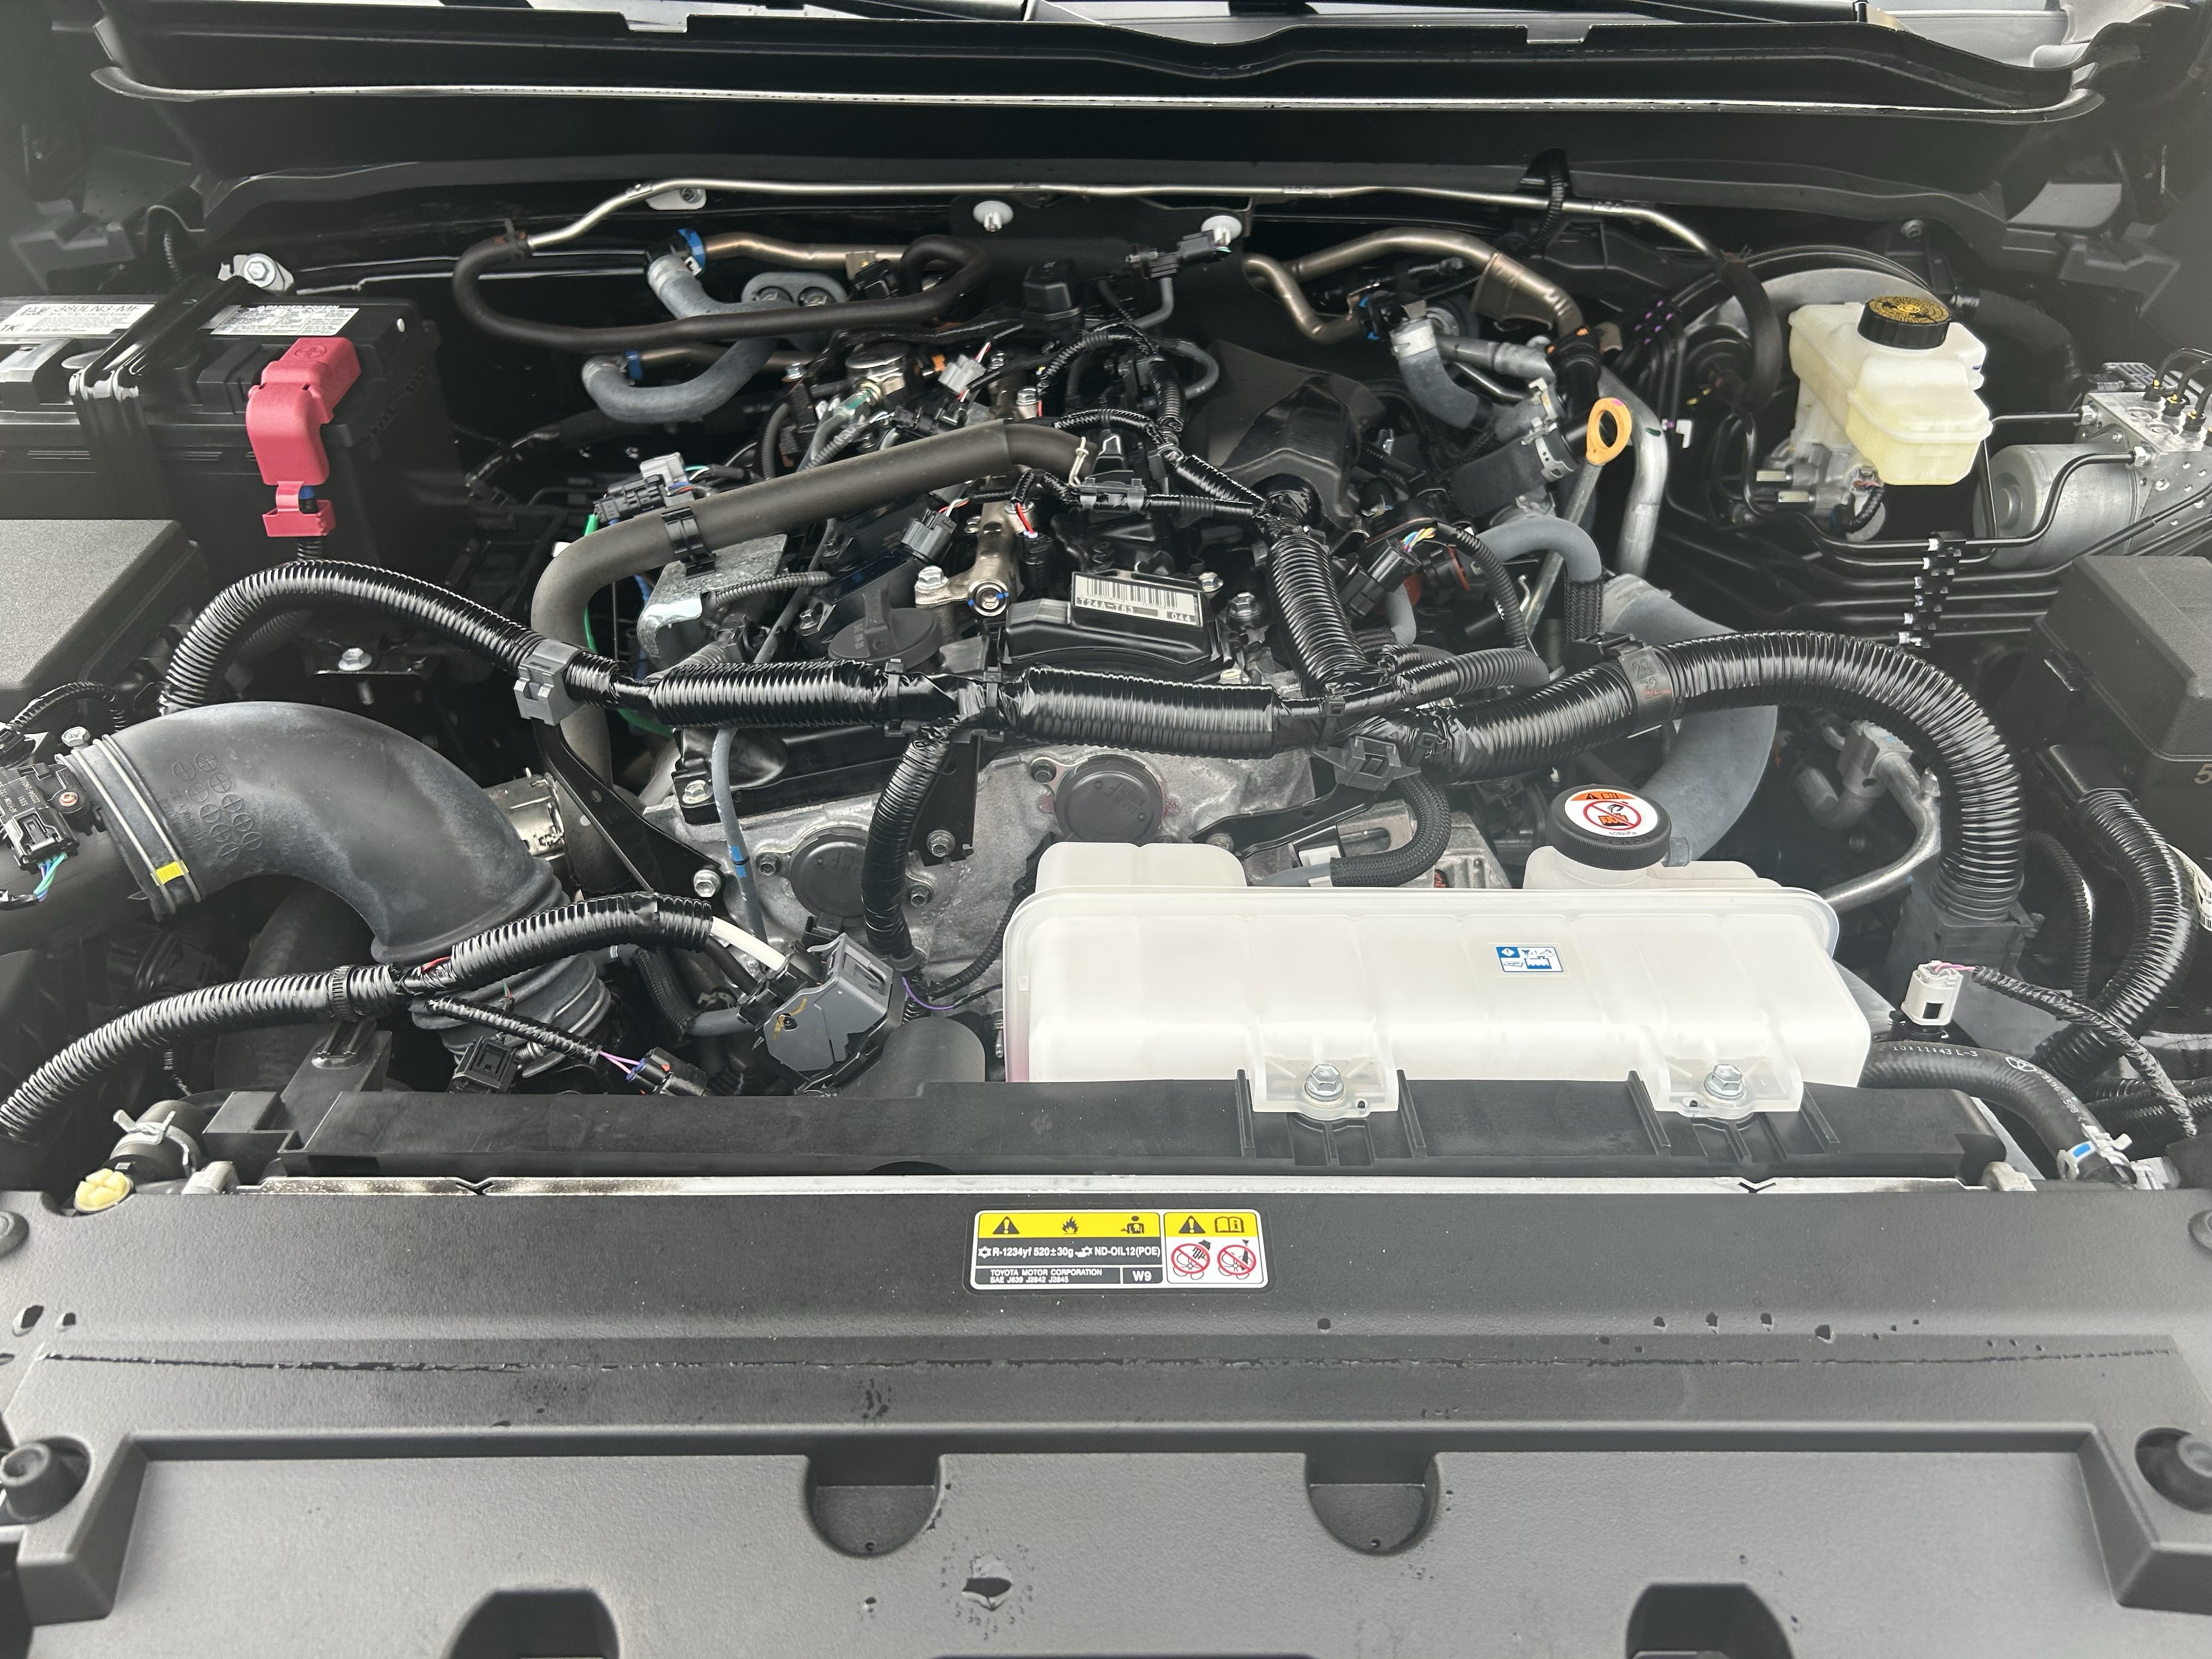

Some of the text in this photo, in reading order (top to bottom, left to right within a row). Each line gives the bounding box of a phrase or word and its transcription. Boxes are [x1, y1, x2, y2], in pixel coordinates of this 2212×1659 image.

[1171, 613, 1191, 622] 044
[1640, 676, 1663, 699] 32
[1955, 1048, 1978, 1057] L-3
[992, 1246, 1161, 1259] R-1234yf 520±30g ND-OIL12(POE)
[1132, 1270, 1152, 1282] W9
